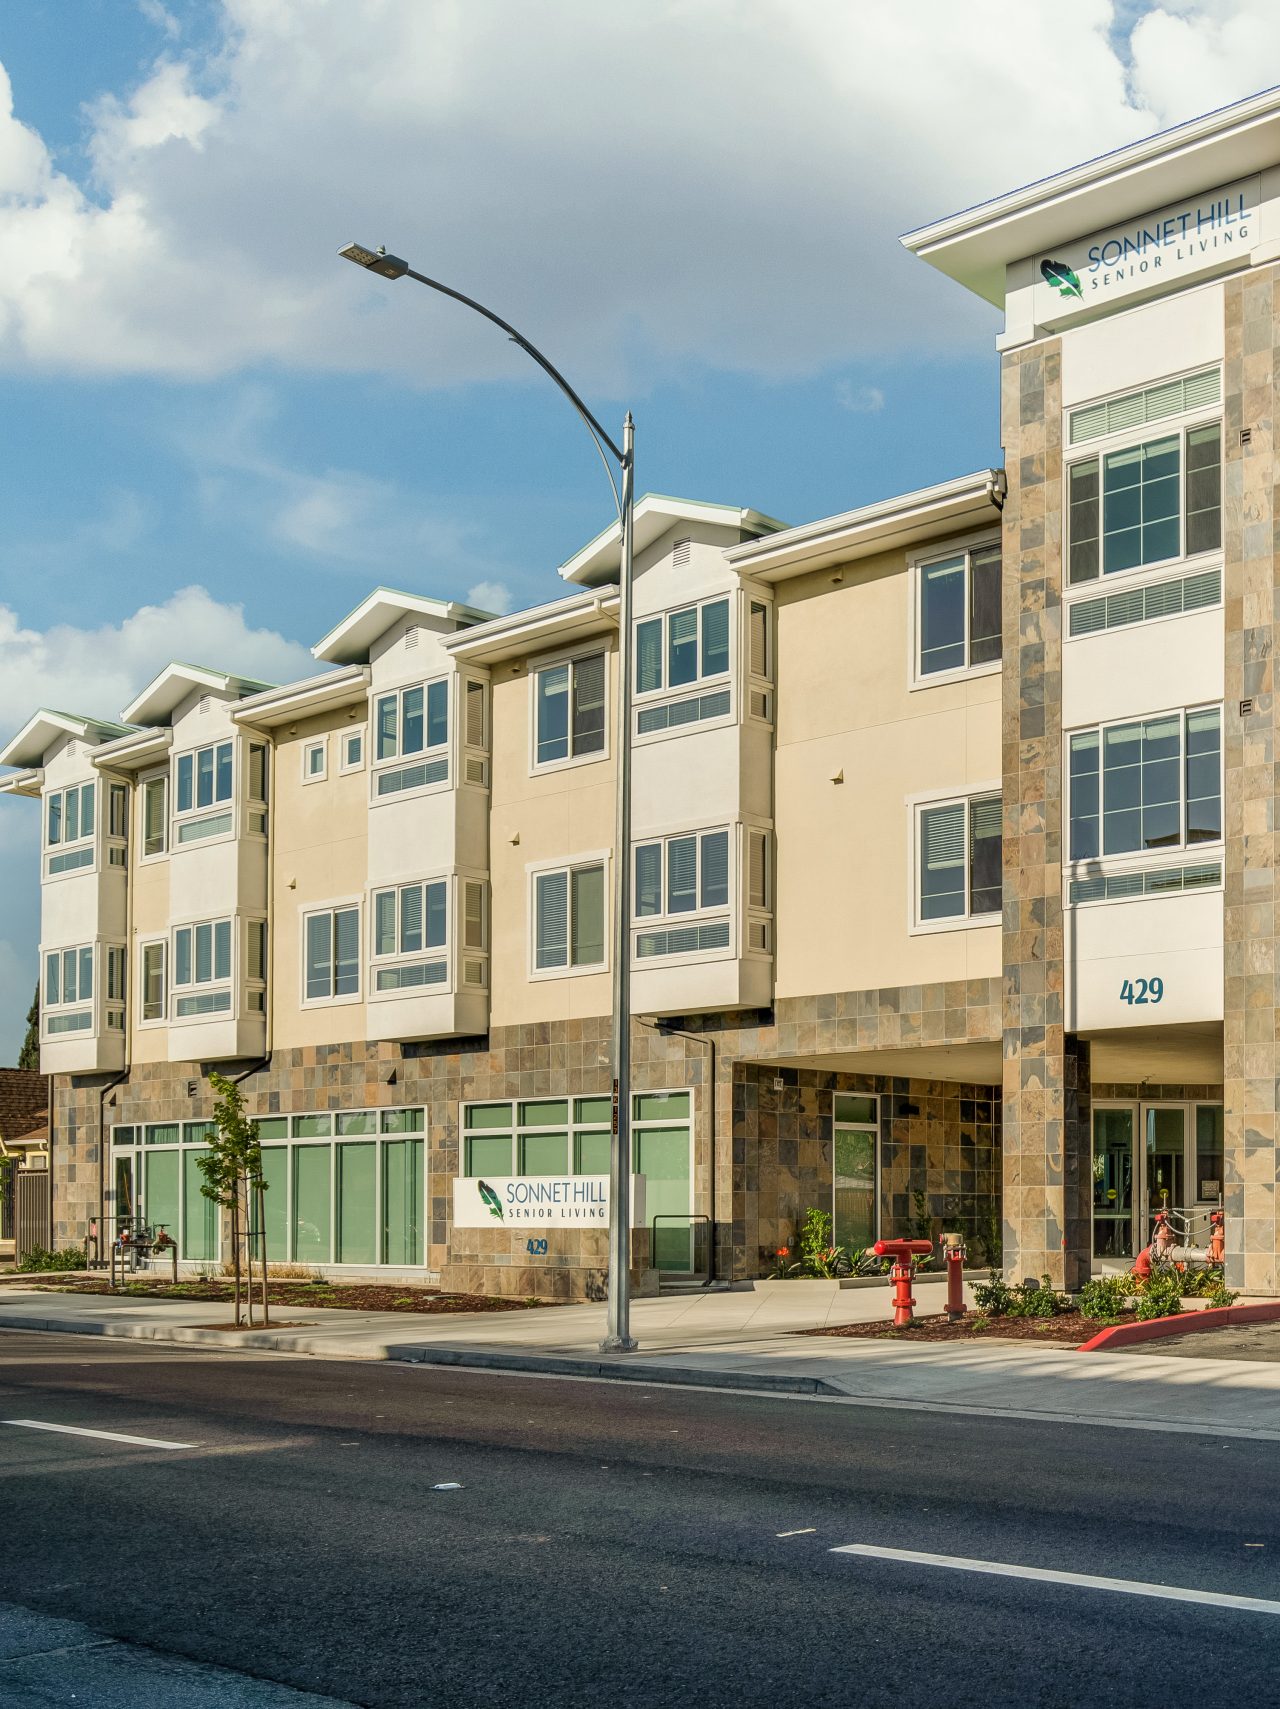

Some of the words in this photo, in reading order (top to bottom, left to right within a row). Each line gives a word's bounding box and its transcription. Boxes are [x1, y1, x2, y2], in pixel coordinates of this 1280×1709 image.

[1088, 213, 1190, 273] SONNET
[1197, 194, 1251, 234] HILL
[1091, 256, 1162, 290] SENIOR
[1177, 226, 1249, 260] LIVING
[1120, 977, 1163, 1005] 429
[507, 1183, 570, 1203] SONNET
[574, 1182, 606, 1202] HILL
[509, 1209, 552, 1217] SENIOR
[561, 1208, 605, 1217] LIVING
[527, 1239, 547, 1255] 429
